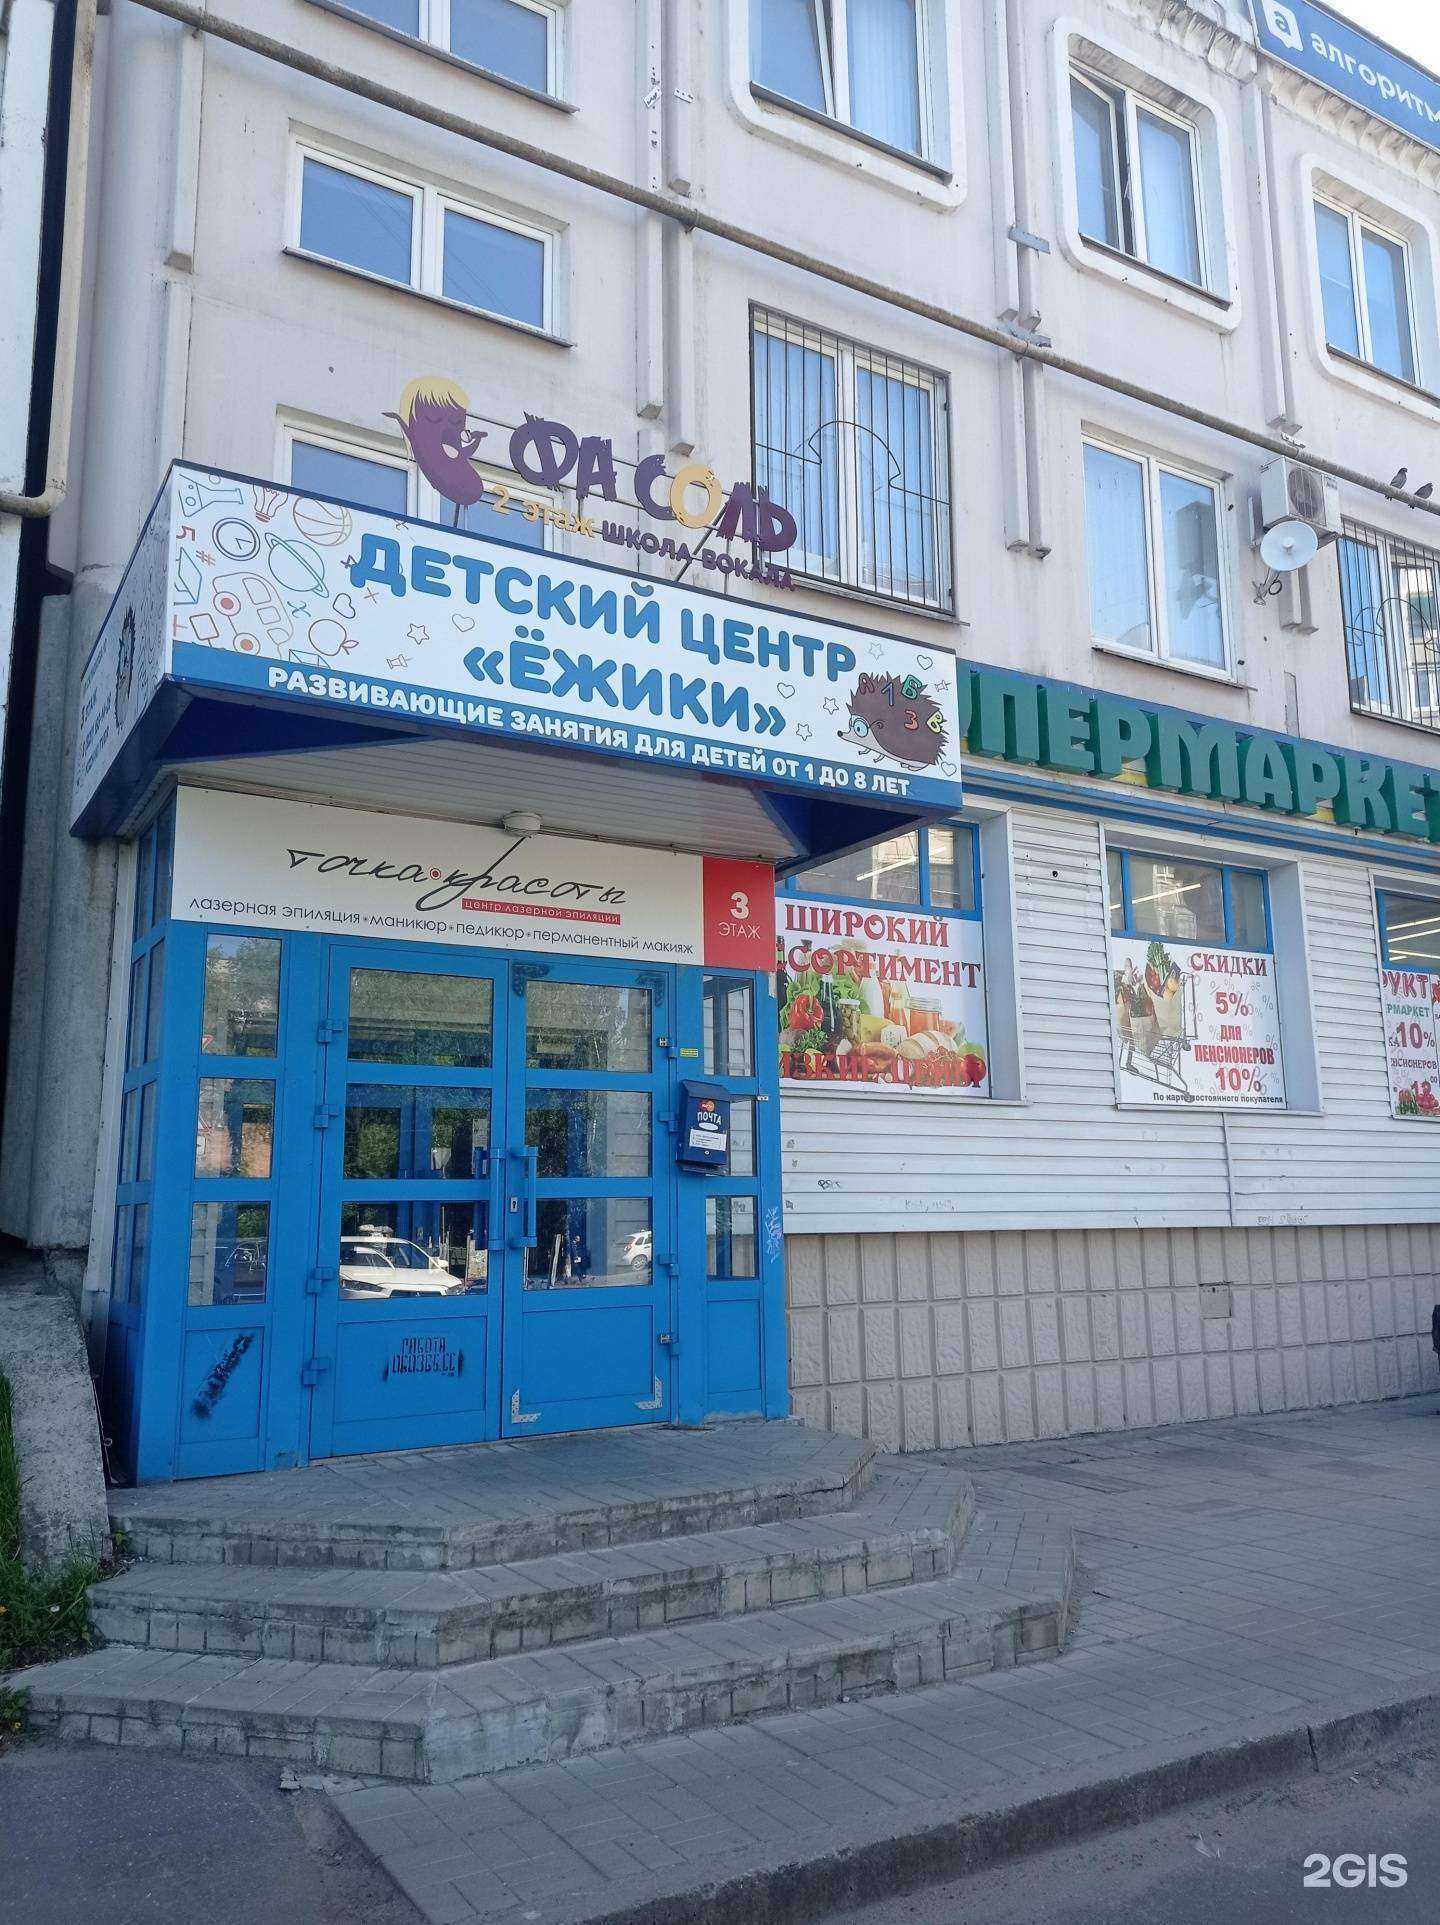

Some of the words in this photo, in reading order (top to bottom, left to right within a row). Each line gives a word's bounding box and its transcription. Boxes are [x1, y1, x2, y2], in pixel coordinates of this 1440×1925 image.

[1310, 32, 1440, 123] алгоритм
[509, 411, 798, 552] ФАСОЛЬ
[491, 486, 510, 515] 2
[522, 501, 595, 538] этаж
[602, 520, 694, 562] ШКОЛА
[702, 548, 795, 591] ВОКАЛА
[350, 533, 660, 644] ДЕТСКИЙ
[681, 608, 857, 682] ЦЕНТР
[463, 625, 787, 737] «ЁЖИКИ»
[881, 681, 895, 707] 1
[268, 667, 504, 726] РАЗВИВАЮЩИЕ
[510, 711, 628, 749] ЗАНЯТИЯ
[634, 732, 686, 759] ДЛЯ
[692, 744, 767, 777] ДЕТЕЙ
[772, 758, 799, 779] ОТ
[805, 763, 814, 782] 1
[818, 766, 849, 787] ДО
[854, 770, 867, 790] 8
[871, 775, 910, 797] ЛЕТ
[904, 709, 919, 731] 3
[465, 901, 501, 912] центр
[506, 905, 562, 919] лазерной
[565, 912, 619, 924] эпиляции
[730, 891, 750, 919] 3
[189, 897, 276, 917] лазерная
[282, 906, 360, 926] эпиляция
[369, 915, 447, 934] маникюр
[456, 922, 525, 941] педикюр
[533, 928, 639, 951] перманентный
[642, 939, 694, 955] макияж
[718, 922, 761, 940] ЭТАЖ
[785, 903, 950, 948] ШИРОКИЙ
[777, 940, 981, 988] СОРТИМЕНТ
[1190, 953, 1268, 977] СКИДКИ
[1215, 991, 1249, 1016] 5%
[1220, 1025, 1242, 1042] ДЛЯ
[1396, 1021, 1436, 1049] 10%
[1194, 1044, 1275, 1065] ПЕНСИОНЕРОВ
[1215, 1067, 1262, 1093] 10%
[1153, 1092, 1165, 1102] По
[697, 1111, 722, 1125] ПОЧТА
